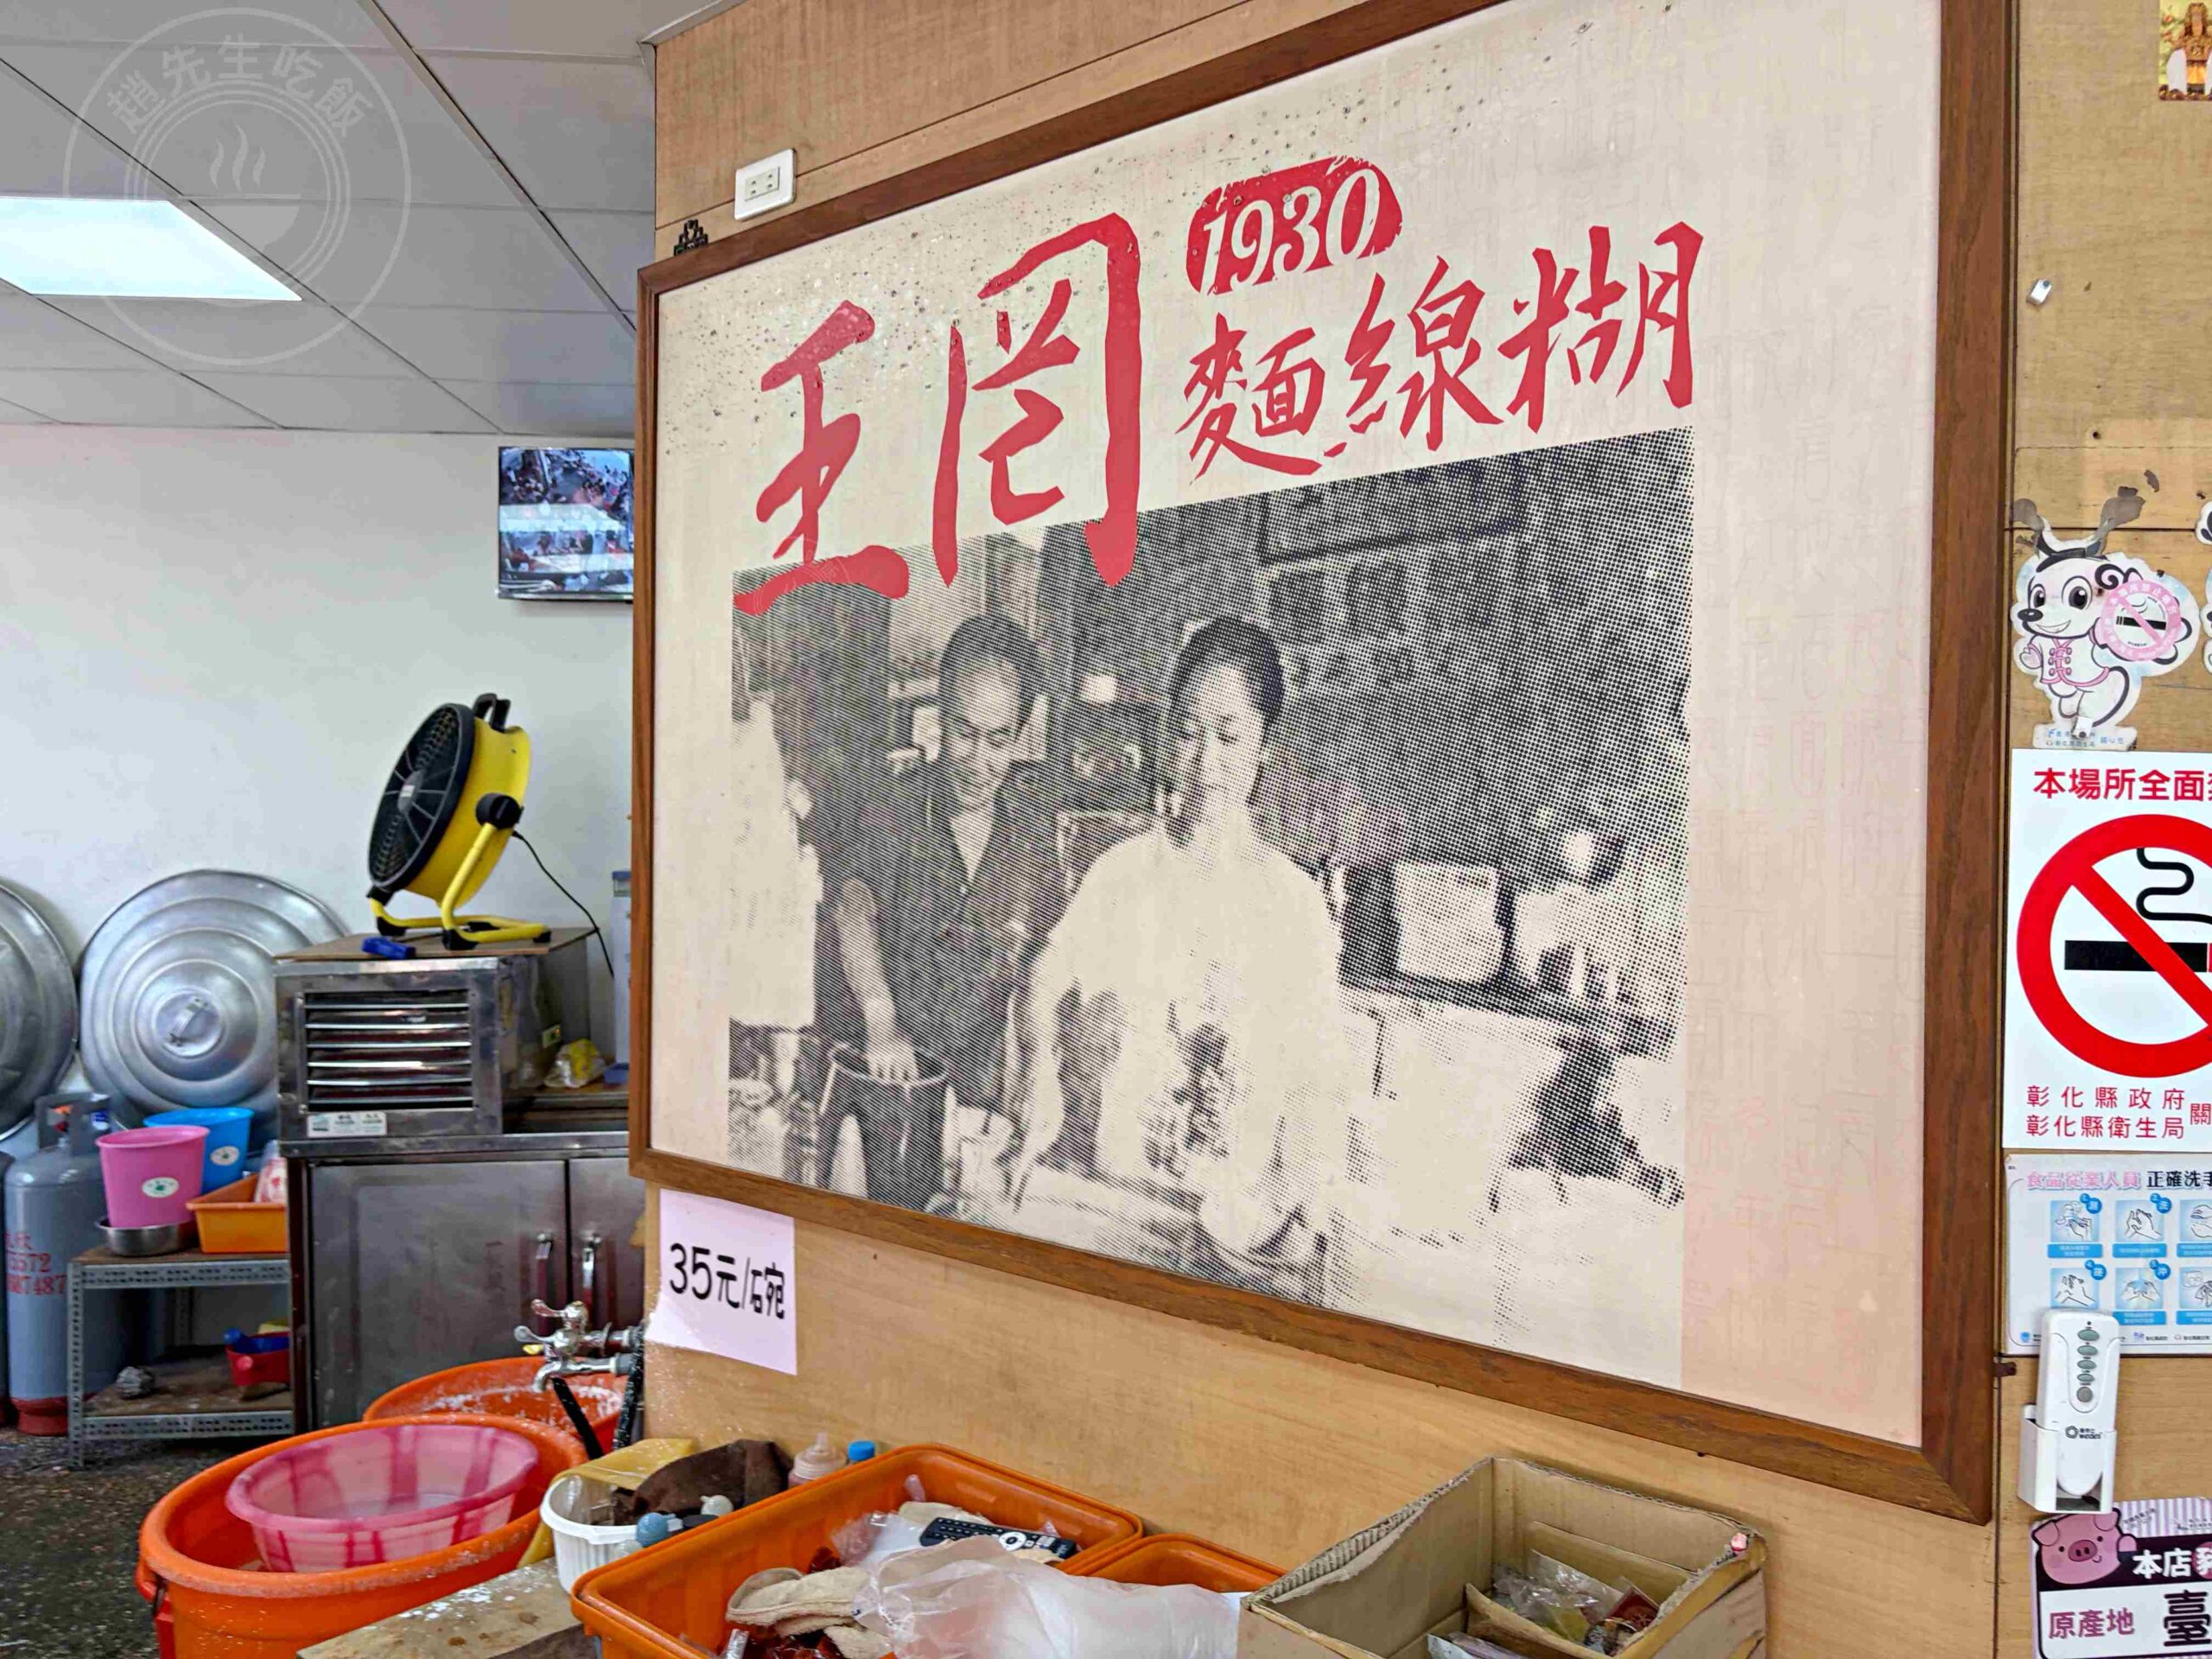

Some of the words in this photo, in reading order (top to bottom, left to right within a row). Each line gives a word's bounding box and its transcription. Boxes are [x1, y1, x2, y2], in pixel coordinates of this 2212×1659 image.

[1202, 168, 1380, 296] 1930
[1176, 221, 1703, 486] 麵線糊
[2033, 767, 2212, 801] 本場所全面
[2026, 1085, 2185, 1110] 彰化縣政府
[2026, 1114, 2184, 1139] 彰化縣衛生局
[670, 1243, 785, 1319] 35元/碗
[2049, 1607, 2135, 1639] 原產地
